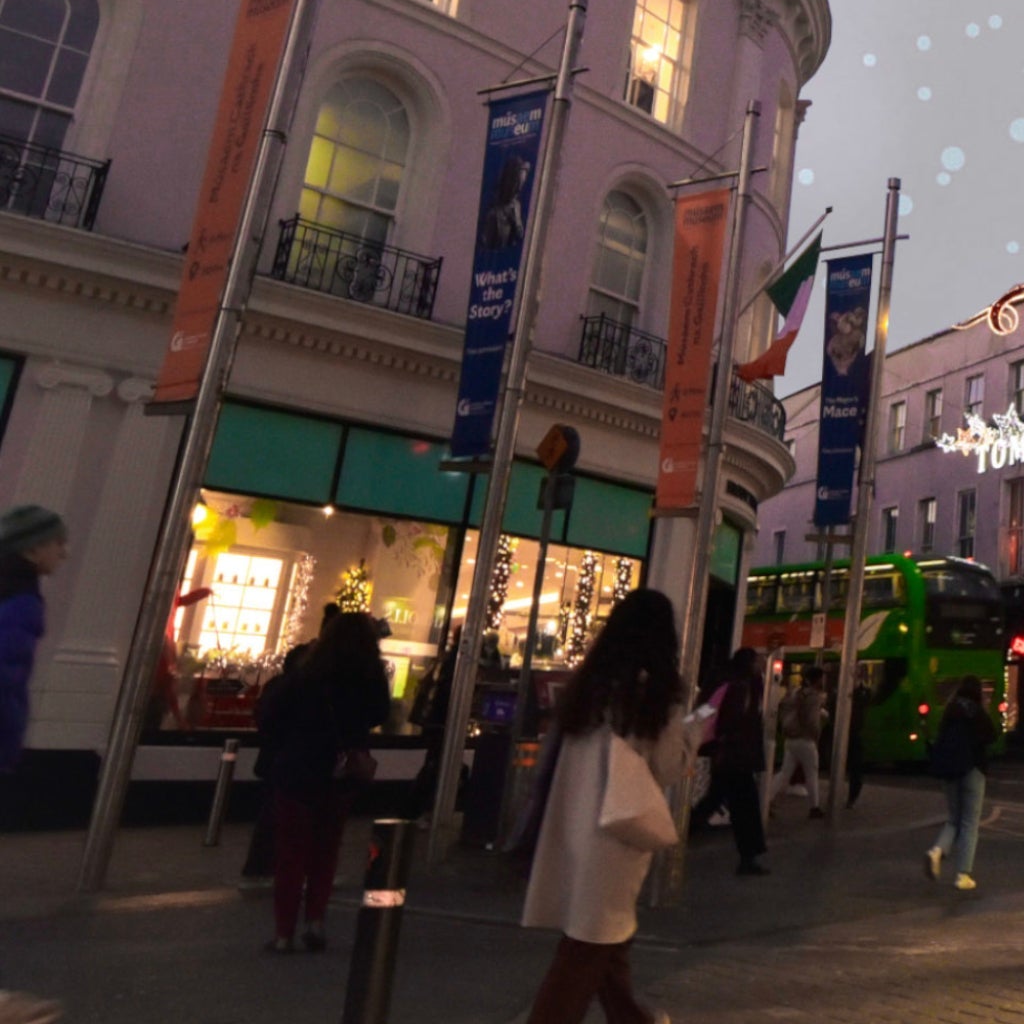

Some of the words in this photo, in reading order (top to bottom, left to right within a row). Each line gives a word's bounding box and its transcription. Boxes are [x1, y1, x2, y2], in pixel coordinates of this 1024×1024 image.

[475, 267, 517, 287] What's
[483, 286, 503, 302] the
[469, 299, 512, 319] Story?
[823, 405, 858, 418] Mace
